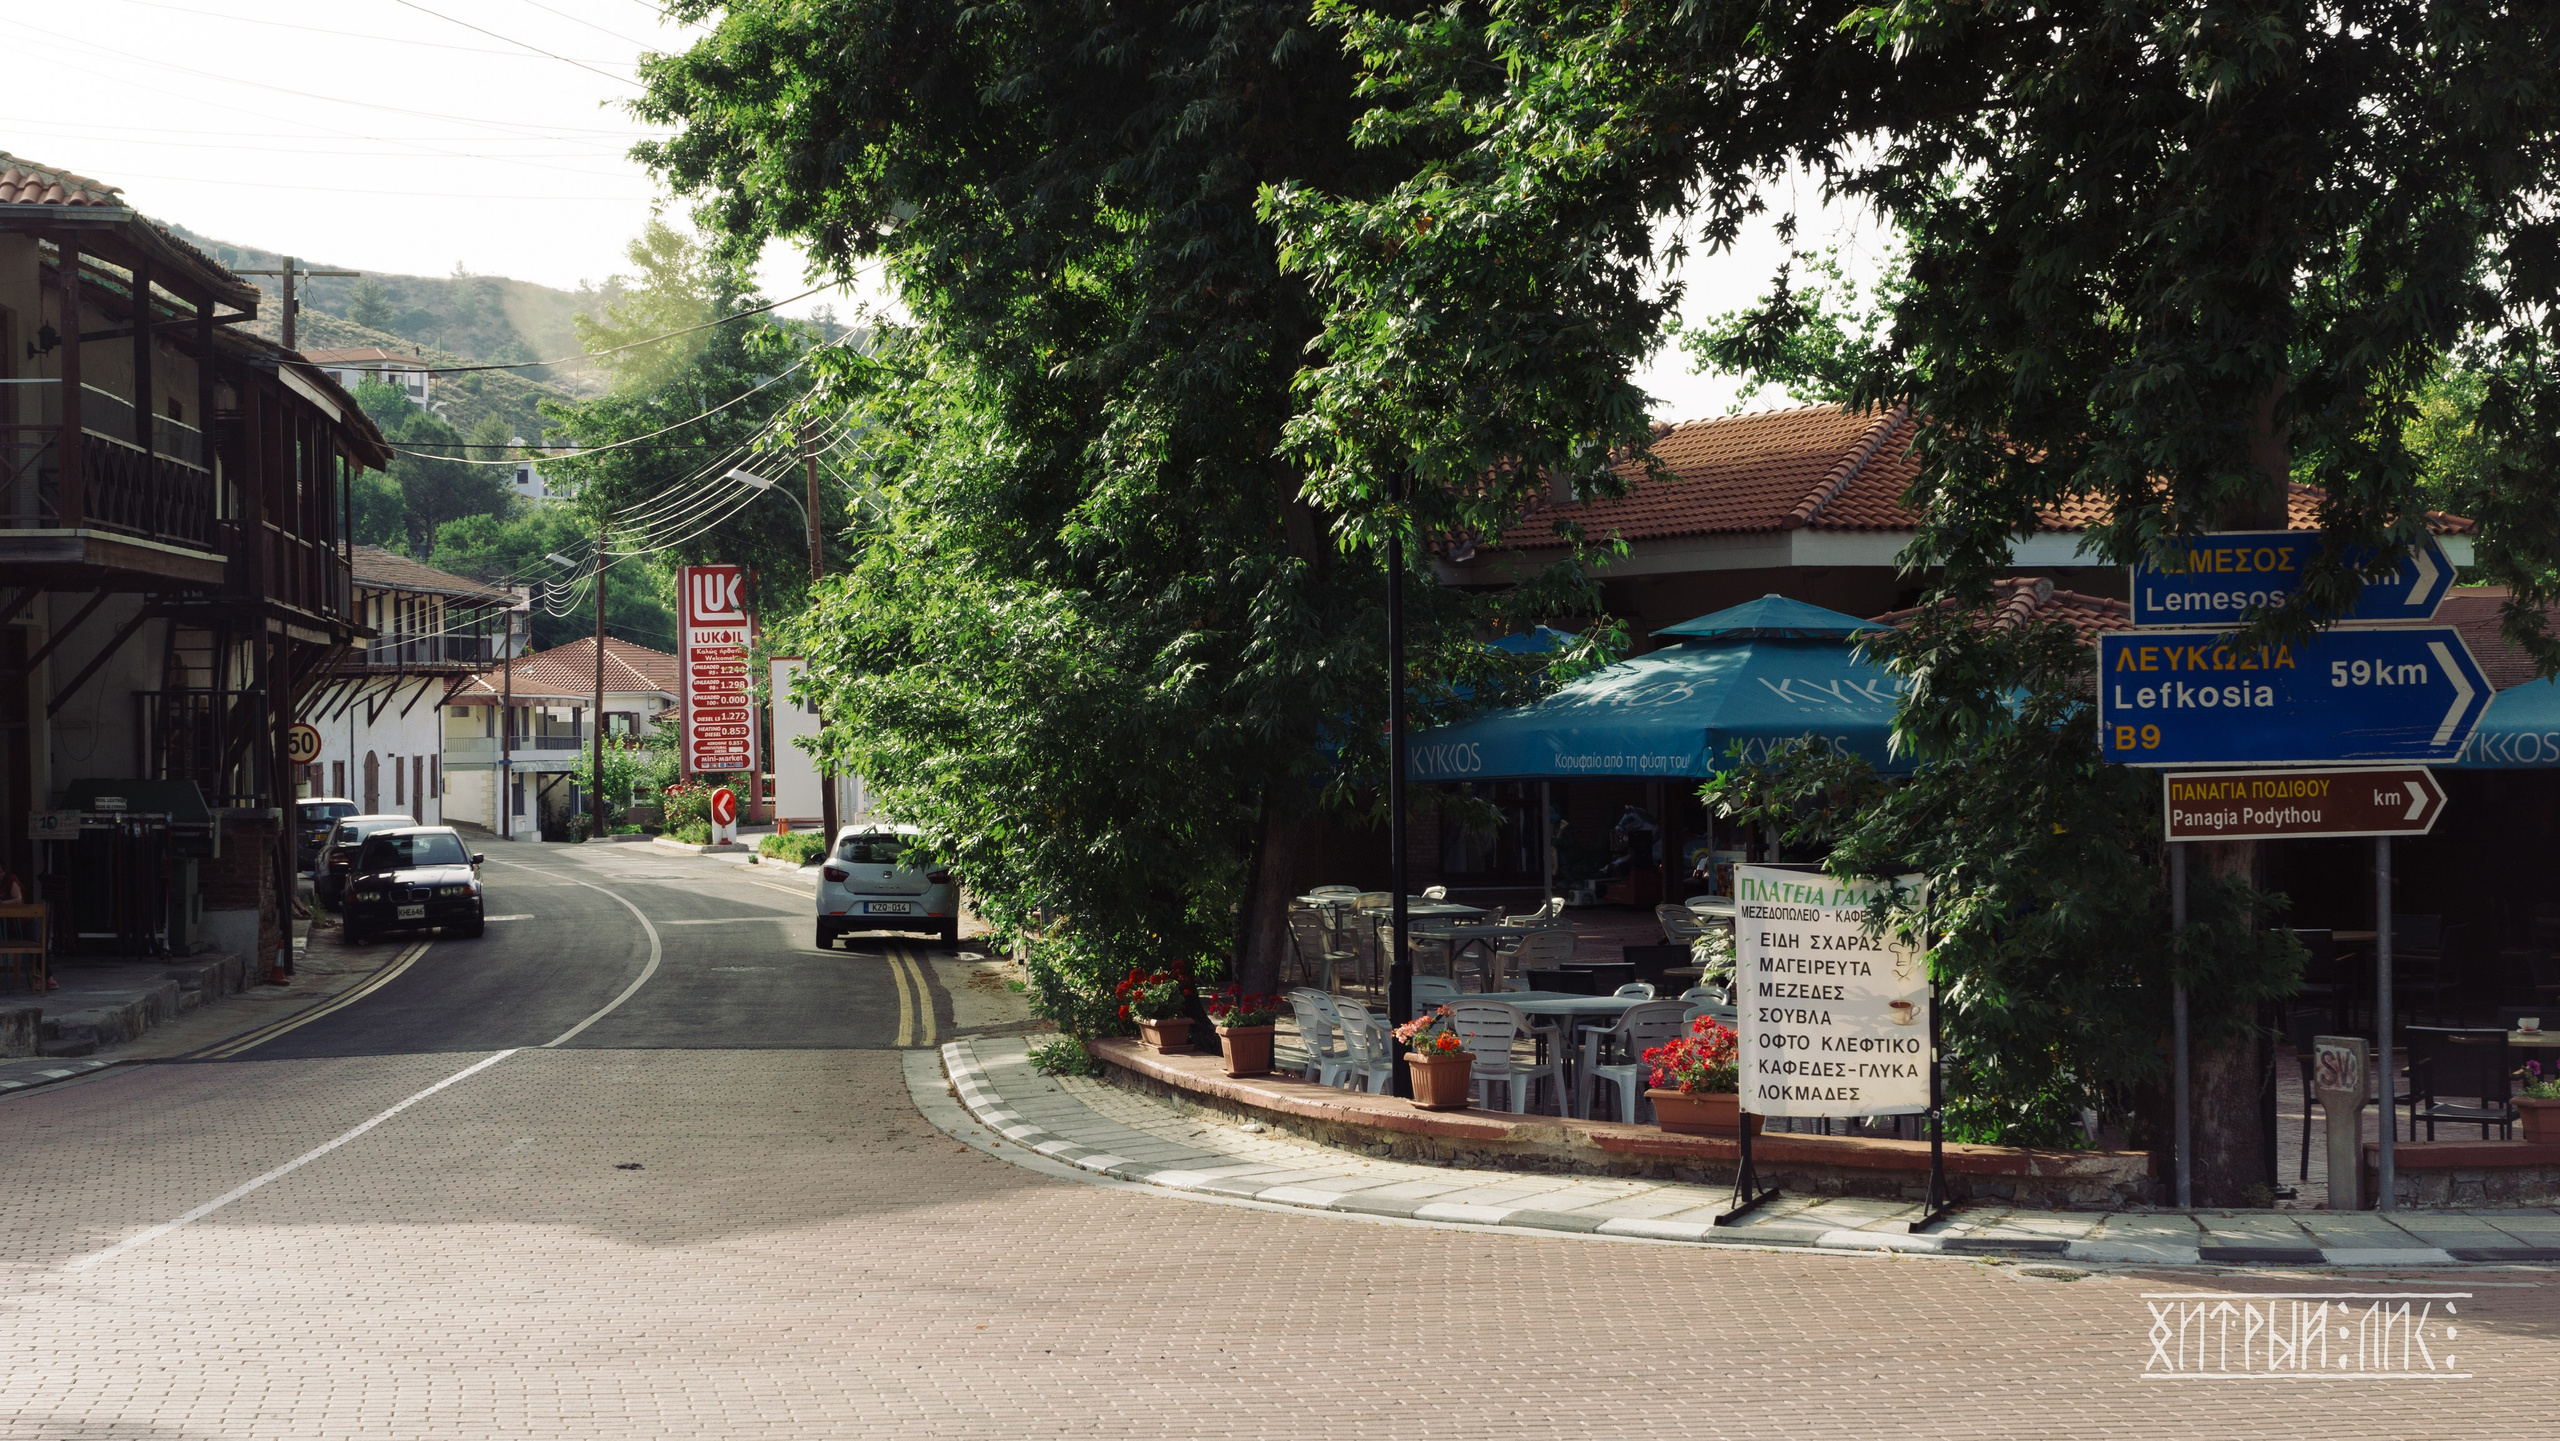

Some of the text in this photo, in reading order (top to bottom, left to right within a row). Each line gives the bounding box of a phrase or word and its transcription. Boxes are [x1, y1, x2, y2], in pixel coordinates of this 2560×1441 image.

[2146, 547, 2296, 574] ΜΕΣΟΣ
[2146, 587, 2287, 612] Lemesos
[694, 630, 744, 643] LUKOIL
[2115, 645, 2296, 672] ΛΕΥΚΩΣΙΑ
[2331, 659, 2429, 688] 59km
[720, 681, 746, 689] 1.298
[2115, 680, 2275, 710] Lefkosia
[720, 696, 746, 704] 0.000
[721, 712, 746, 720] 1.272
[721, 727, 747, 735] 0.853
[2115, 724, 2162, 750] B9
[290, 732, 314, 755] 50
[2465, 732, 2560, 763] YKKOS
[1411, 742, 1481, 775] KYKKOS
[1555, 752, 1602, 771] Κορυφαίο
[1604, 751, 1623, 768] από
[1625, 755, 1637, 771] τη
[1640, 752, 1667, 772] φύση
[2172, 779, 2331, 801] ΠΑΝΑΓΙΑ ΠΟΔΙΘΟΥ
[2373, 789, 2401, 806] km
[2173, 806, 2322, 829] Panagia Podythou
[1741, 878, 1922, 907] ΠΛΑΤΕΙΑ ΓΑΛΣ
[1741, 906, 1820, 922] ΜΕΖΕΔΟΠΩΛΕΙΟ
[1760, 932, 1883, 951] ΕΙΔΗ ΣΧΑΡΑΣ
[1759, 957, 1872, 976] ΜΑΓΕΙΡΕΥΤΑ
[1759, 982, 1845, 1001] ΜΕΖΕΔΕΣ
[1758, 1007, 1832, 1026] ΣΟΥΒΛΑ
[1759, 1033, 1920, 1053] ΟΦΤΟ ΚΛΕΦΤΙΚΟ
[1759, 1059, 1919, 1078] ΚΑΦΕΔΕΣ-ΓΛΥΚΑ
[1758, 1084, 1861, 1101] ΛΟΚΜΑΔΕΣ
